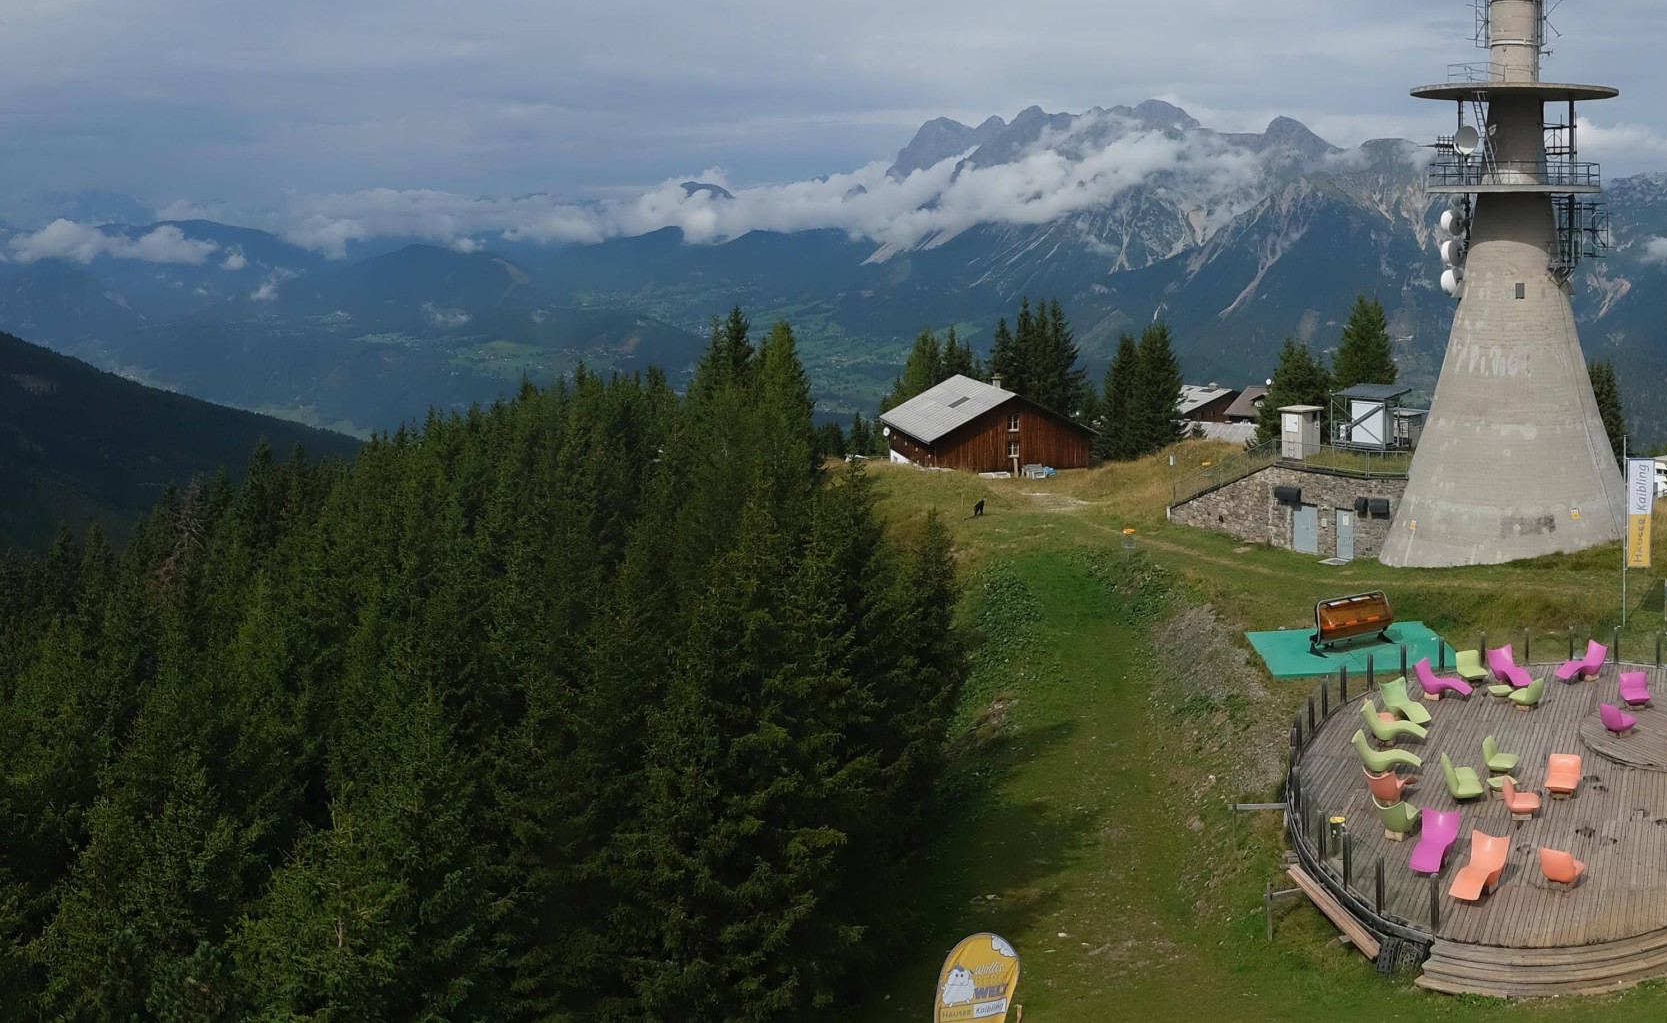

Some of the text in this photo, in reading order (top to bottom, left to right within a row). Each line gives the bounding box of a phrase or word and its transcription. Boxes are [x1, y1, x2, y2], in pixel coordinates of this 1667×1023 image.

[1633, 464, 1650, 563] HAUSER Kaibling
[974, 983, 1009, 999] WELT
[942, 1003, 1004, 1018] HAUSER Kaibling
